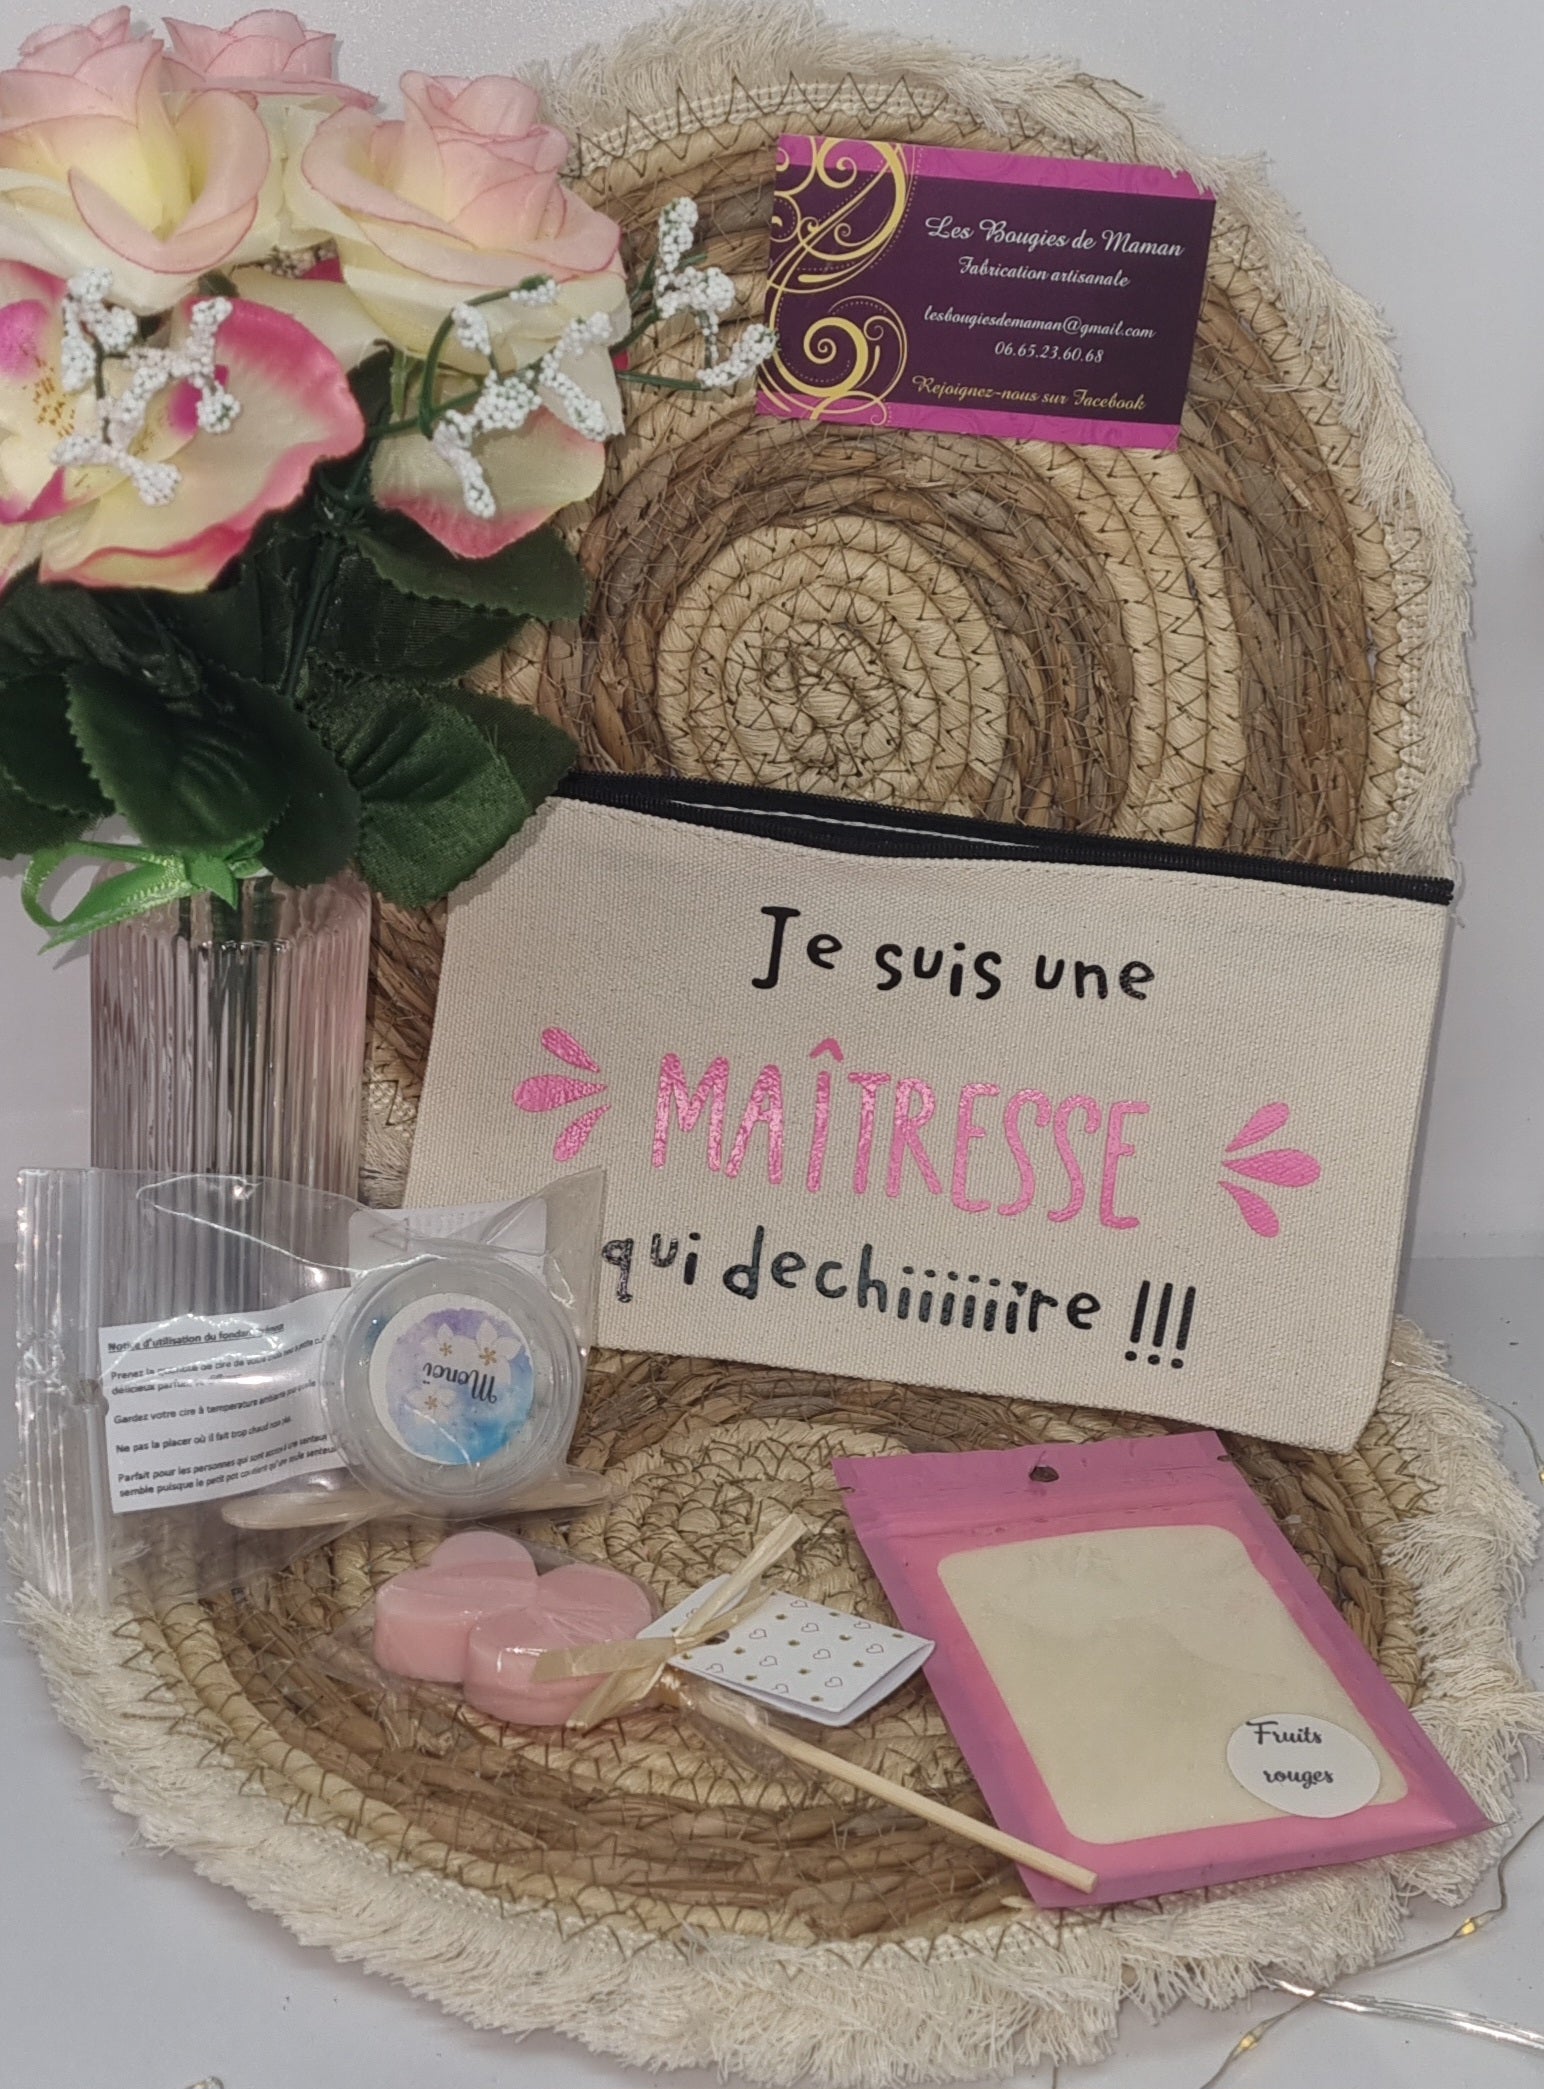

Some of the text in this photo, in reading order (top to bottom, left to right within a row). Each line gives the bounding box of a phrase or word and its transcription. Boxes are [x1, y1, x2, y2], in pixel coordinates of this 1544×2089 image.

[925, 215, 1185, 256] Les Bougies de Maman
[958, 256, 1131, 287] Fabrication artisanale
[924, 305, 1157, 339] lesbougiesdemaman@gmail.com
[994, 340, 1105, 363] 06.65.23.60.68
[912, 375, 1147, 411] Rejoignez-nous sur Facebook
[751, 905, 1156, 1001] Je suis une
[650, 1036, 1151, 1231] MAÎTRESSE
[600, 1230, 701, 1303] qui
[1124, 1279, 1197, 1370] !!!
[108, 1341, 140, 1353] Notie
[204, 1331, 216, 1341] du
[111, 1369, 144, 1380] Prenez
[422, 1362, 498, 1404] Merci
[114, 1412, 149, 1424] Gardez
[150, 1409, 177, 1420] votre
[178, 1407, 196, 1417] cire
[198, 1405, 205, 1414] à
[116, 1444, 130, 1453] Ne
[133, 1443, 149, 1452] pas
[151, 1440, 160, 1449] la
[162, 1438, 192, 1449] placer
[118, 1471, 150, 1482] Parfait
[152, 1468, 176, 1479] pour
[178, 1465, 191, 1475] les
[193, 1459, 235, 1474] personnes
[119, 1485, 154, 1497] semble
[157, 1481, 194, 1494] puisque
[196, 1478, 204, 1487] le
[1245, 1721, 1322, 1745] Fruits
[1263, 1769, 1334, 1789] rouges
